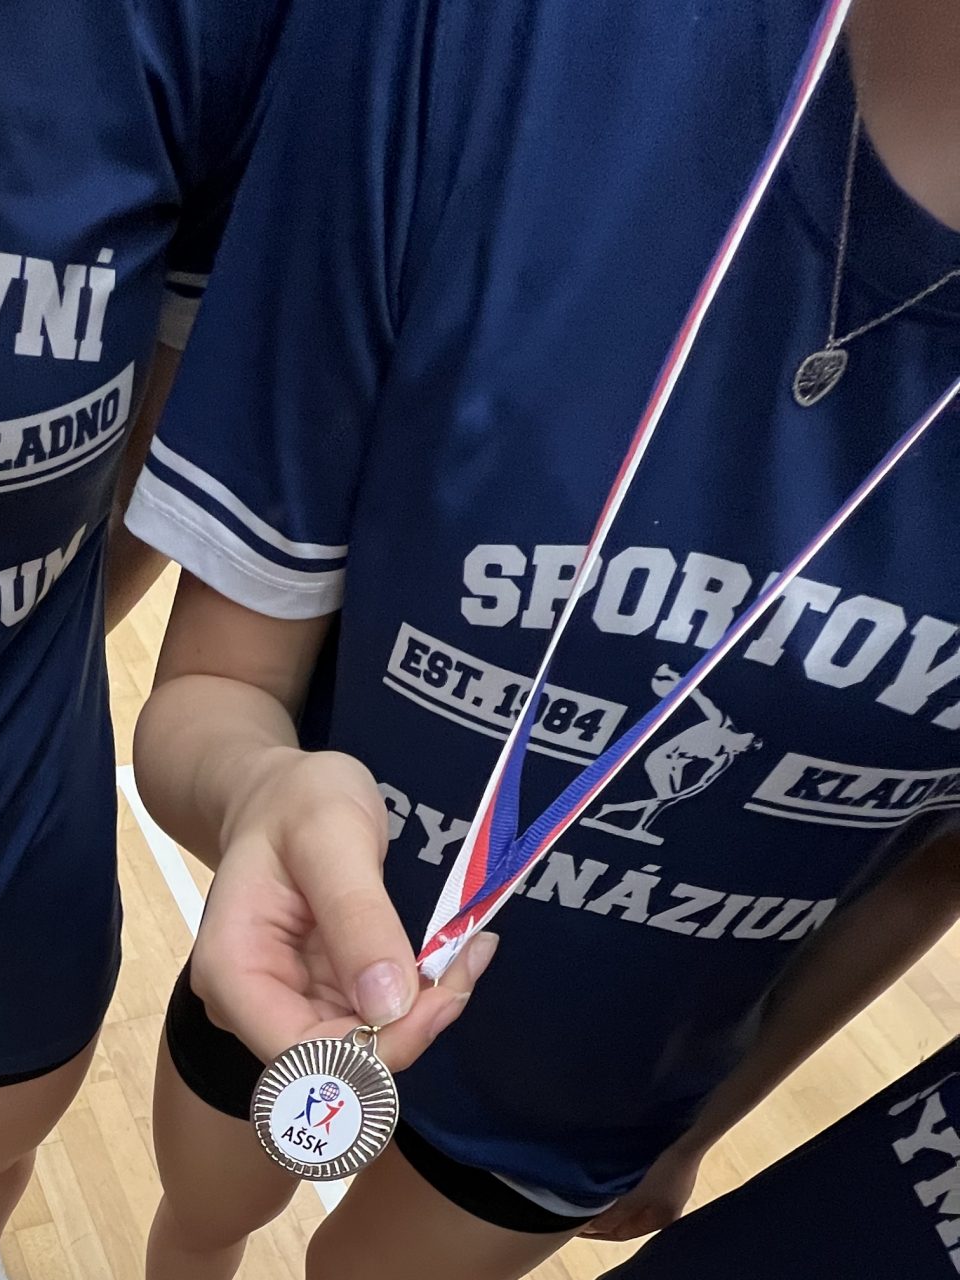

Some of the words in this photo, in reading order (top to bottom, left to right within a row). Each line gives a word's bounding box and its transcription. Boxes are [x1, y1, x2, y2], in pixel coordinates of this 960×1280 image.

[461, 544, 960, 730] SPORTOV
[400, 638, 484, 707] EST.
[281, 1126, 328, 1156] AŠSK
